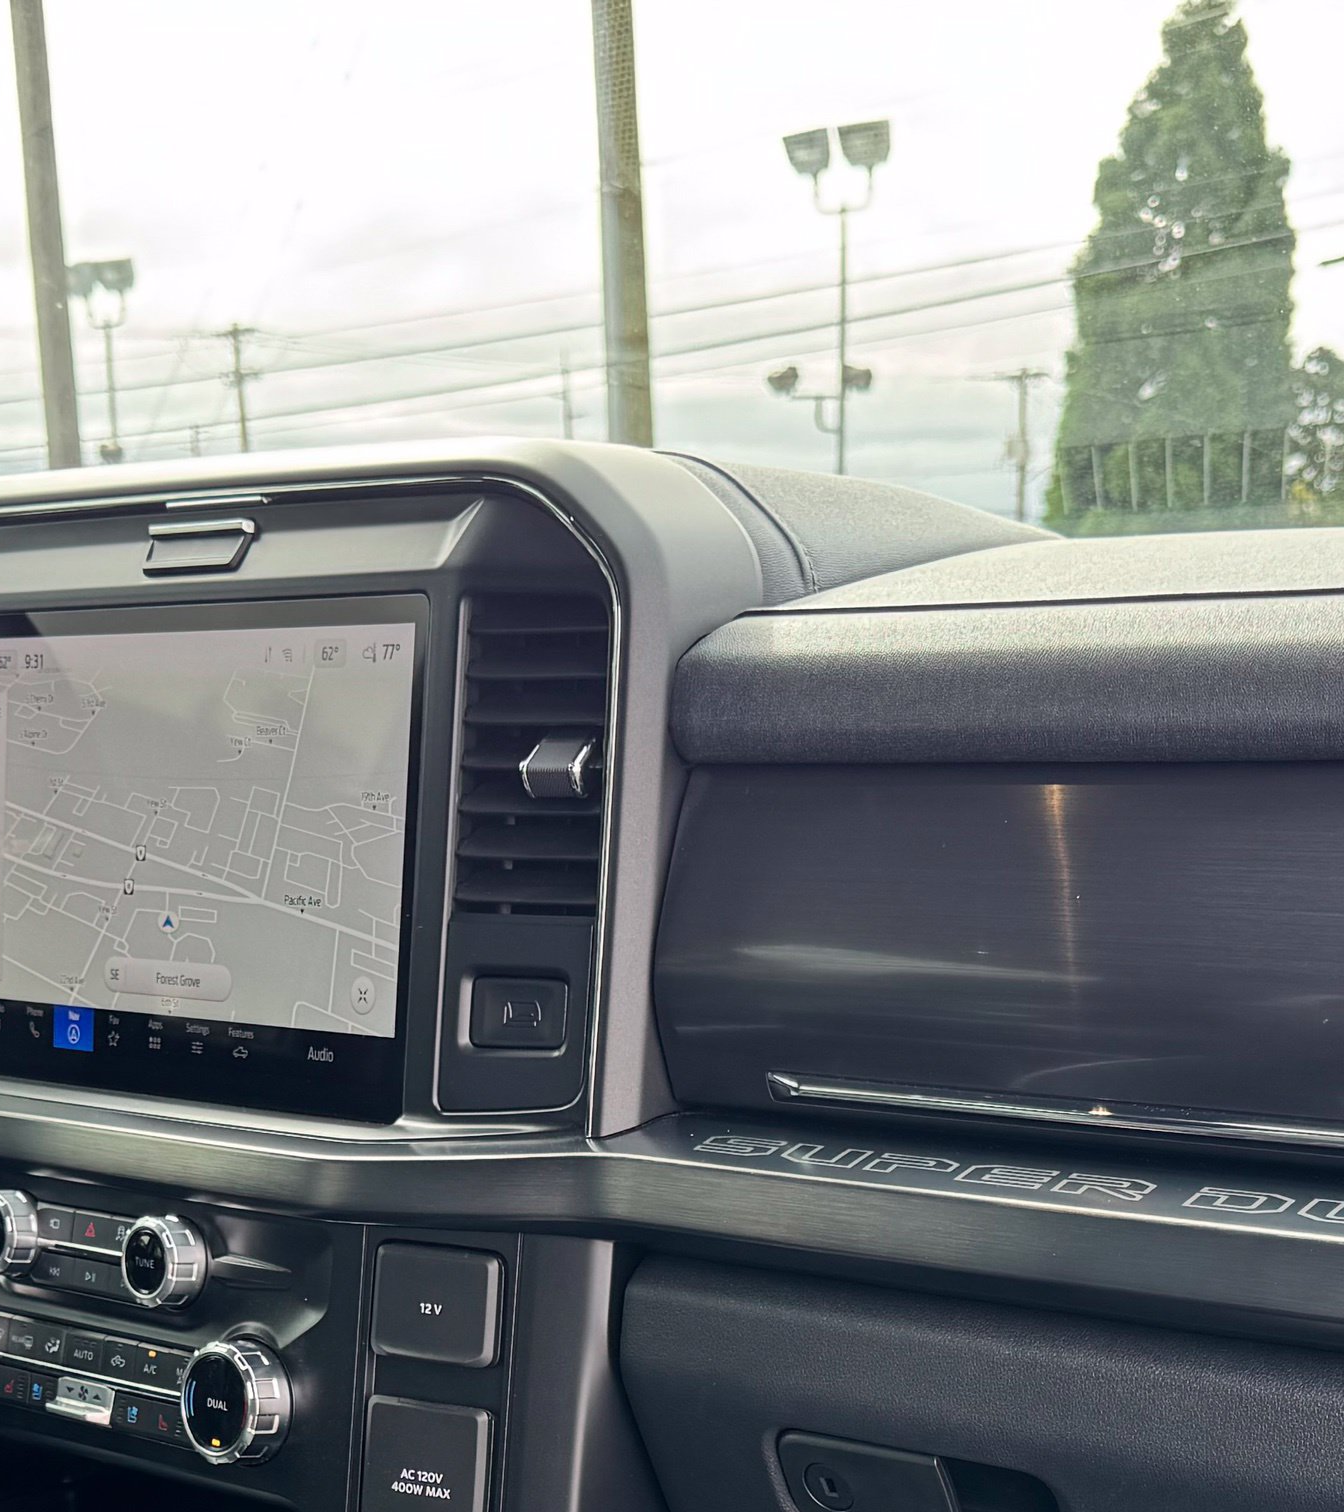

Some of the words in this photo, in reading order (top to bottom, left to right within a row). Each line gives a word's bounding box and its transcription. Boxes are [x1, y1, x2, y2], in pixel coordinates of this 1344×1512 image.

[24, 653, 44, 670] 9:31
[284, 894, 307, 907] Pacific
[307, 895, 322, 907] Ave
[110, 968, 120, 981] SE
[155, 972, 179, 987] Forest
[179, 974, 201, 988] Grove
[148, 1018, 164, 1031] Apps
[185, 1022, 210, 1036] Settings
[227, 1027, 255, 1040] Features
[307, 1046, 335, 1063] Audio
[692, 1134, 1158, 1202] SUPER
[135, 1256, 155, 1269] TUNE
[420, 1302, 432, 1315] 12
[433, 1303, 443, 1316] V
[73, 1349, 94, 1362] AUTO
[143, 1363, 157, 1375] A/C
[206, 1397, 229, 1412] DUAL
[400, 1468, 416, 1480] AC
[417, 1470, 444, 1484] 120V
[391, 1480, 424, 1496] 400W
[425, 1485, 451, 1500] MAX
